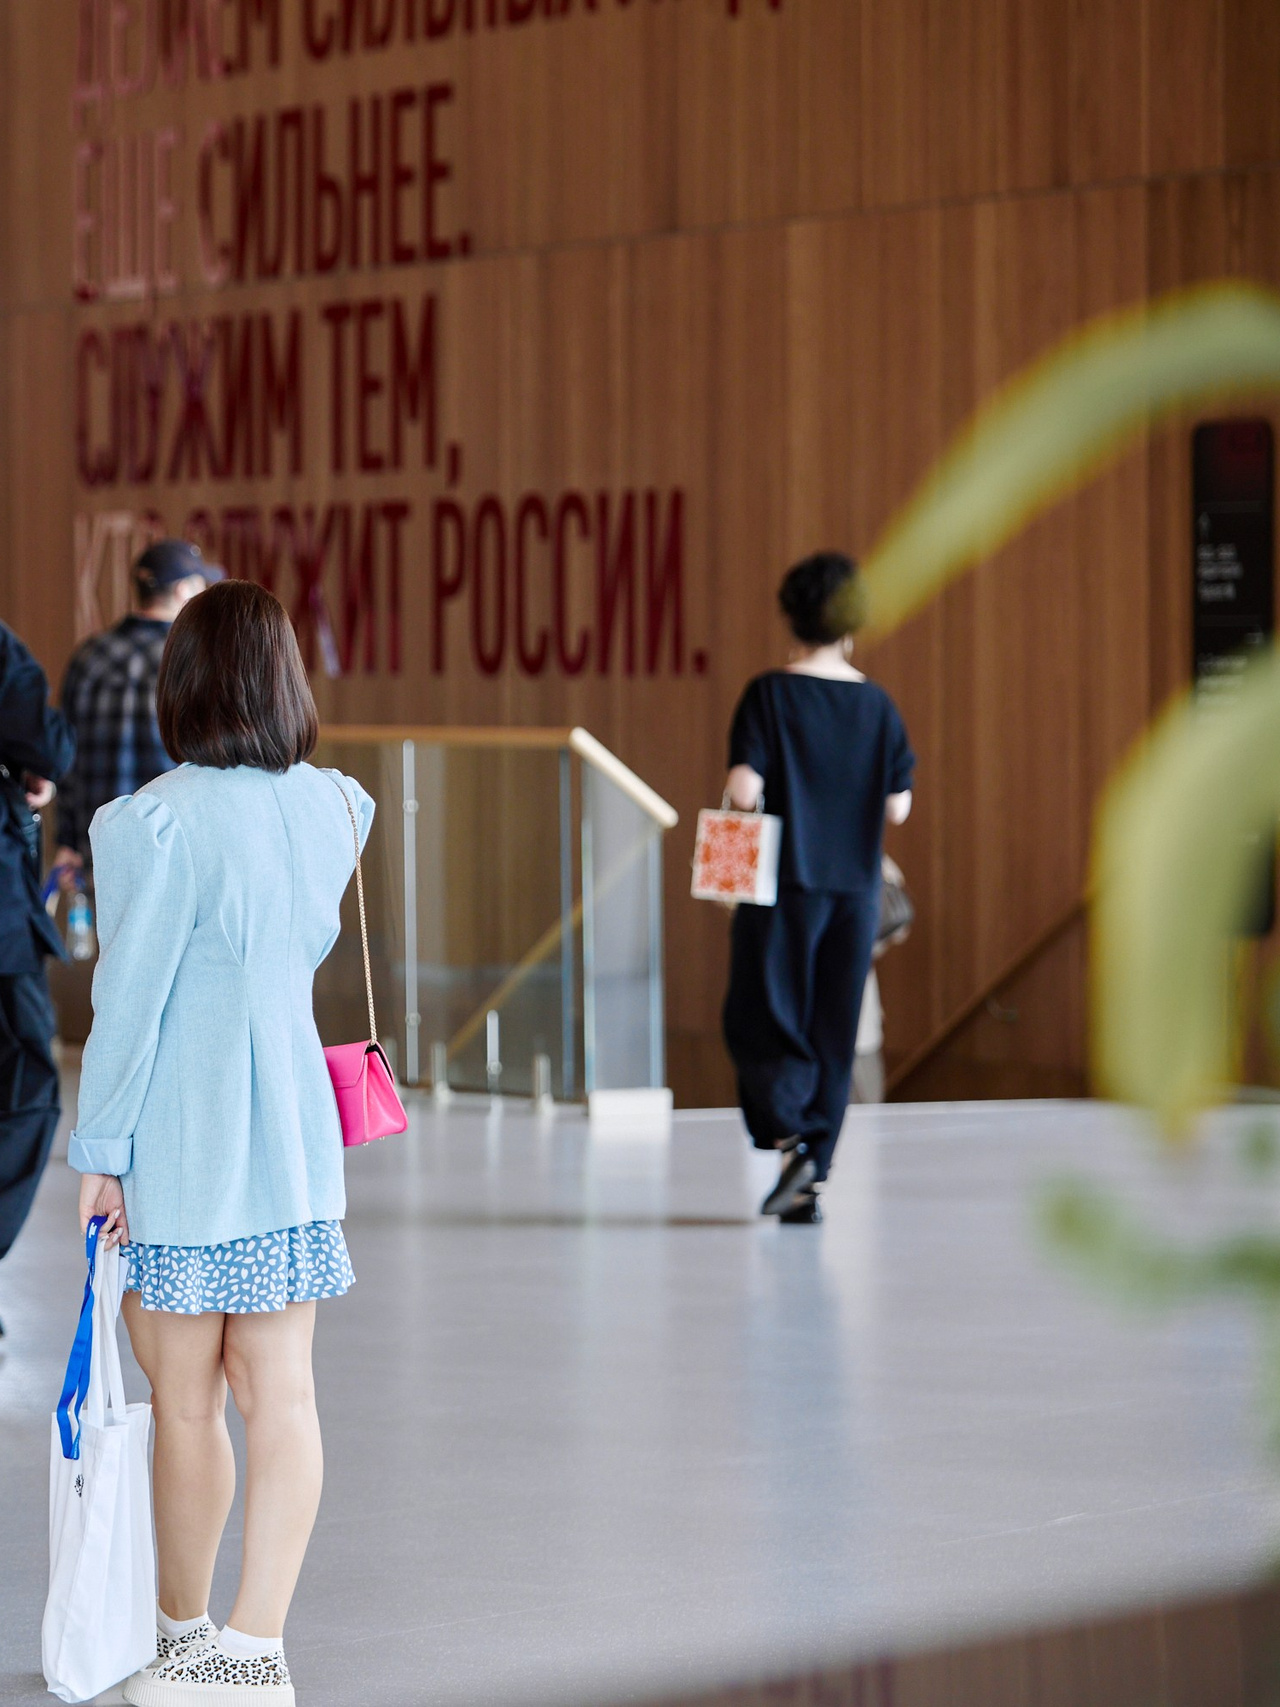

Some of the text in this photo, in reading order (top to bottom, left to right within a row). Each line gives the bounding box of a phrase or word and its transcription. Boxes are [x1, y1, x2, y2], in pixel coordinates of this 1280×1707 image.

[198, 82, 472, 290] СИЛЬНЕЕ.
[76, 292, 462, 490] СЛУЖИМ ТЕМ,
[73, 506, 165, 642] КТ
[429, 490, 708, 678] РОССИИ.
